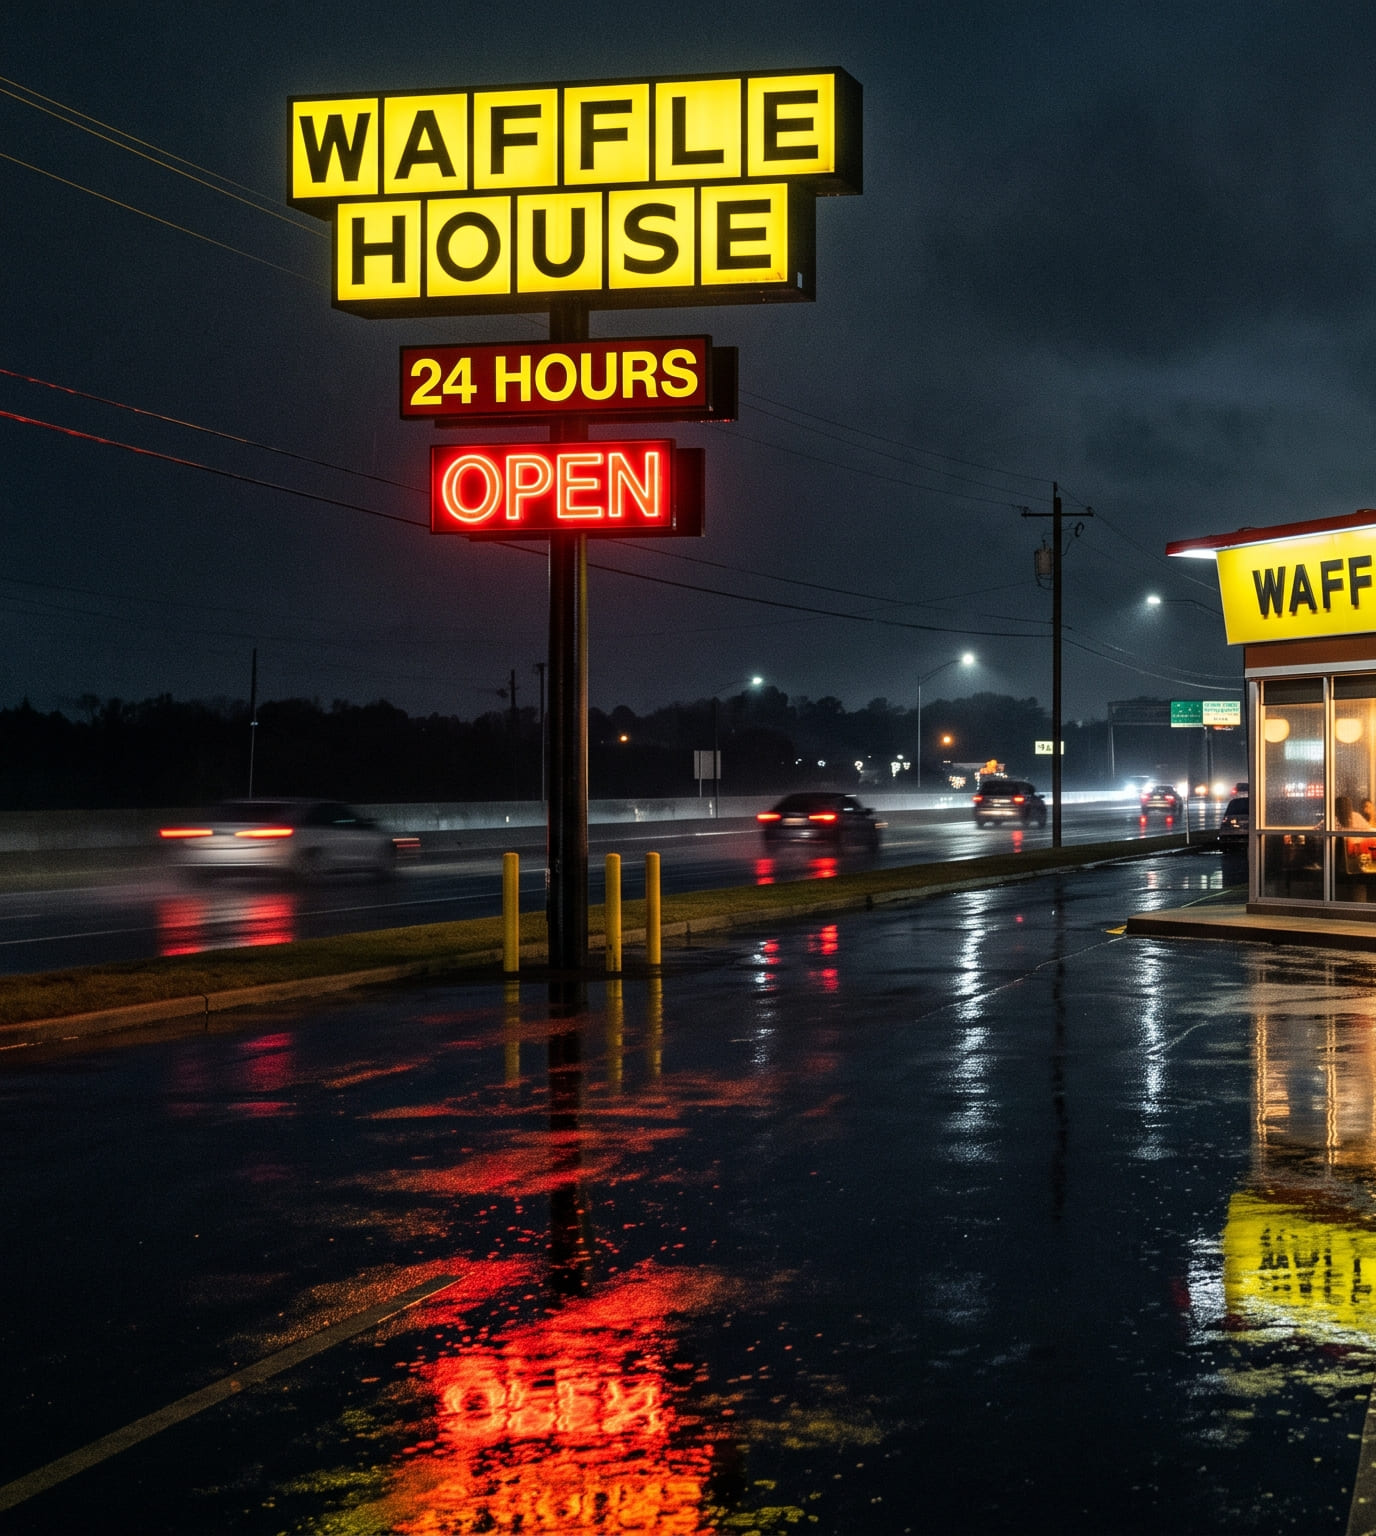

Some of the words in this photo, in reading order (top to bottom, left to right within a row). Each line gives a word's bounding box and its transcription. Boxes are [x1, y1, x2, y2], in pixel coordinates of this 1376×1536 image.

[299, 88, 819, 183] WAFFLE
[351, 198, 772, 285] HOUSE
[410, 357, 477, 406] 24
[495, 348, 699, 403] HOURS
[441, 451, 661, 523] OPEN
